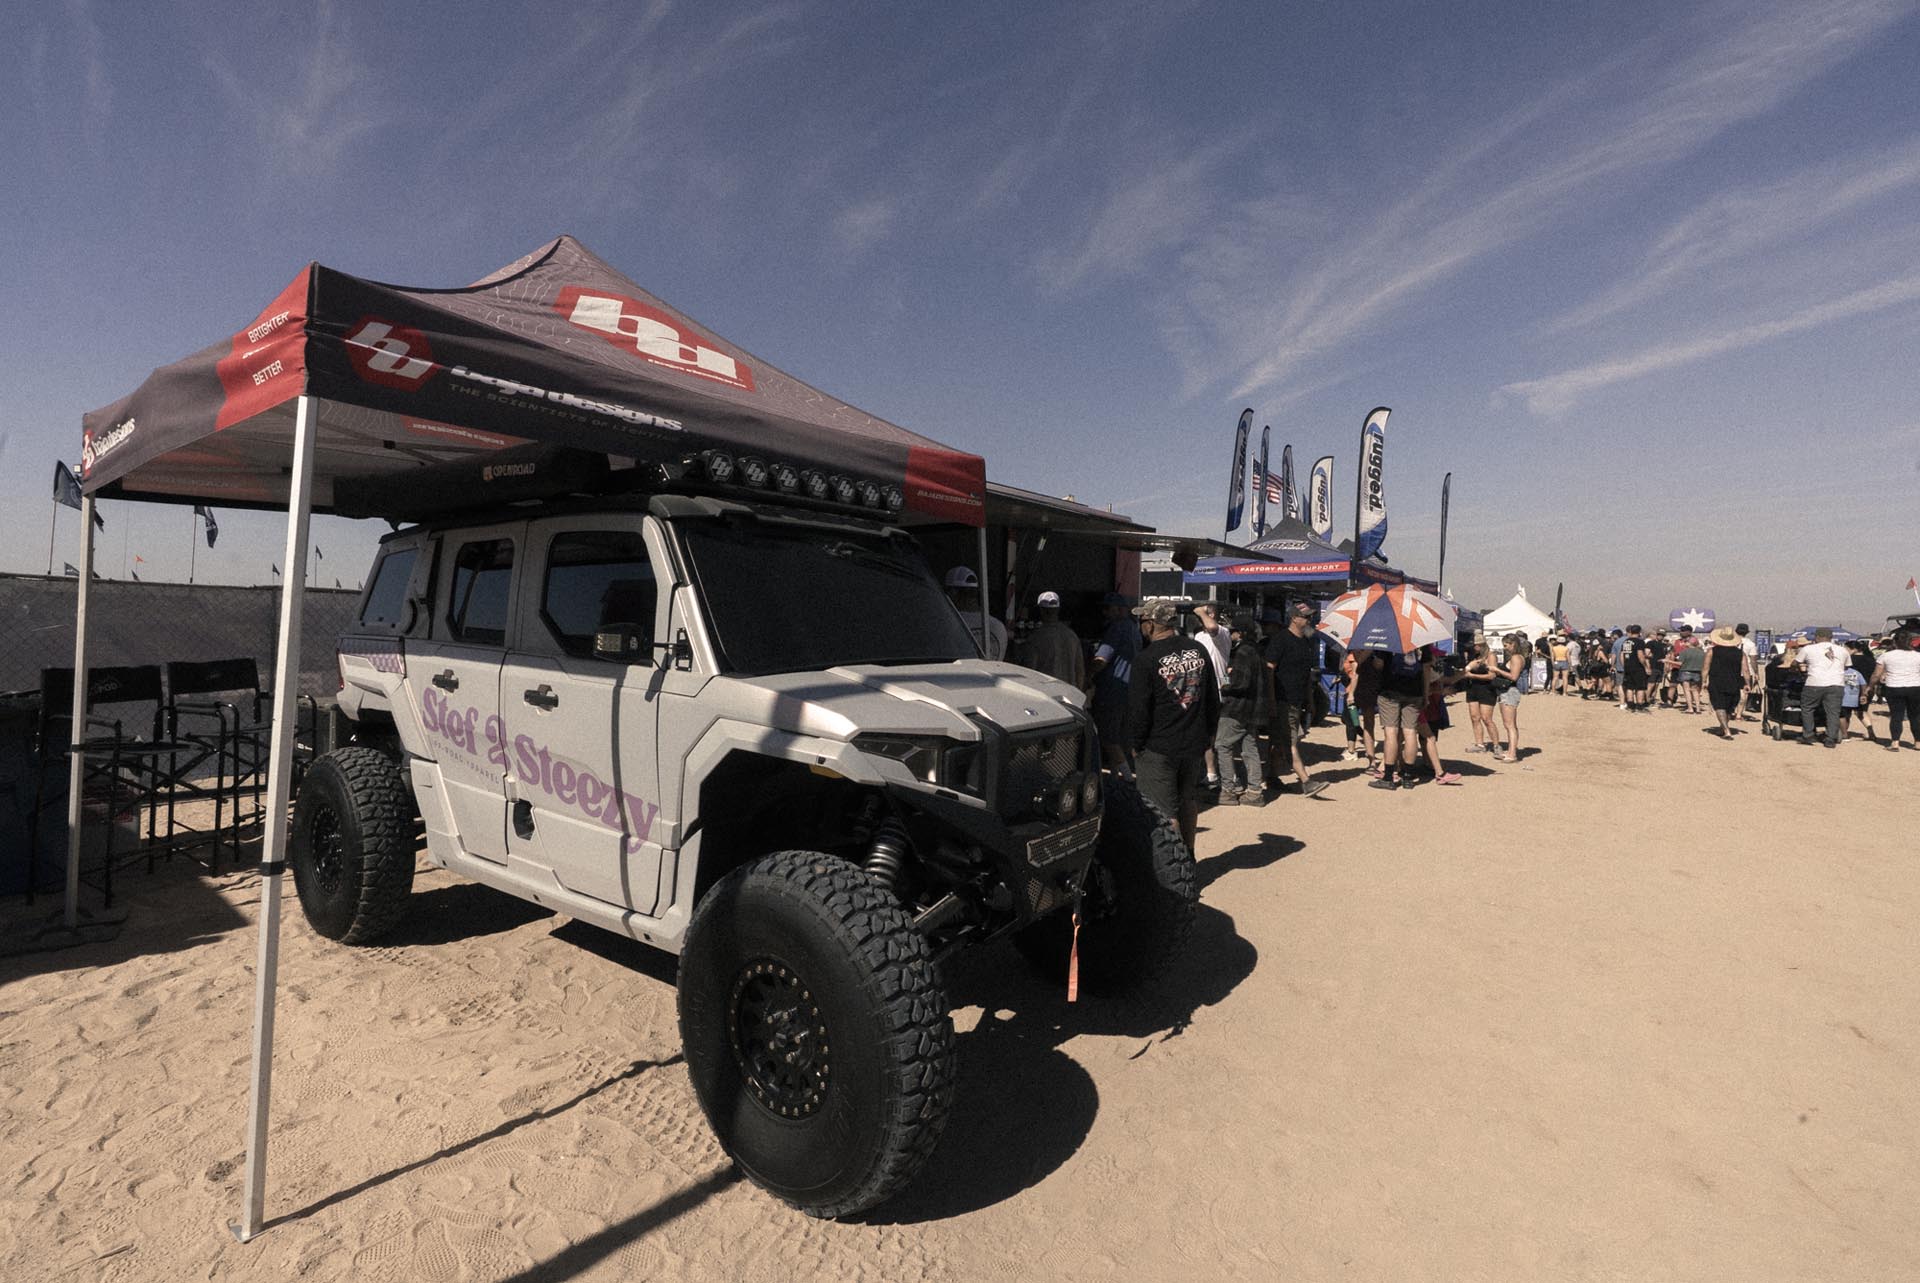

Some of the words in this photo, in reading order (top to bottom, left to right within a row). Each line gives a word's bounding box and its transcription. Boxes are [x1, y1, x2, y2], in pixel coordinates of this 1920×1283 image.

[247, 311, 290, 343] BRIGHTER
[252, 359, 284, 386] BETTER
[449, 383, 481, 396] THE
[422, 687, 479, 756] Stef
[514, 734, 659, 855] Steezy
